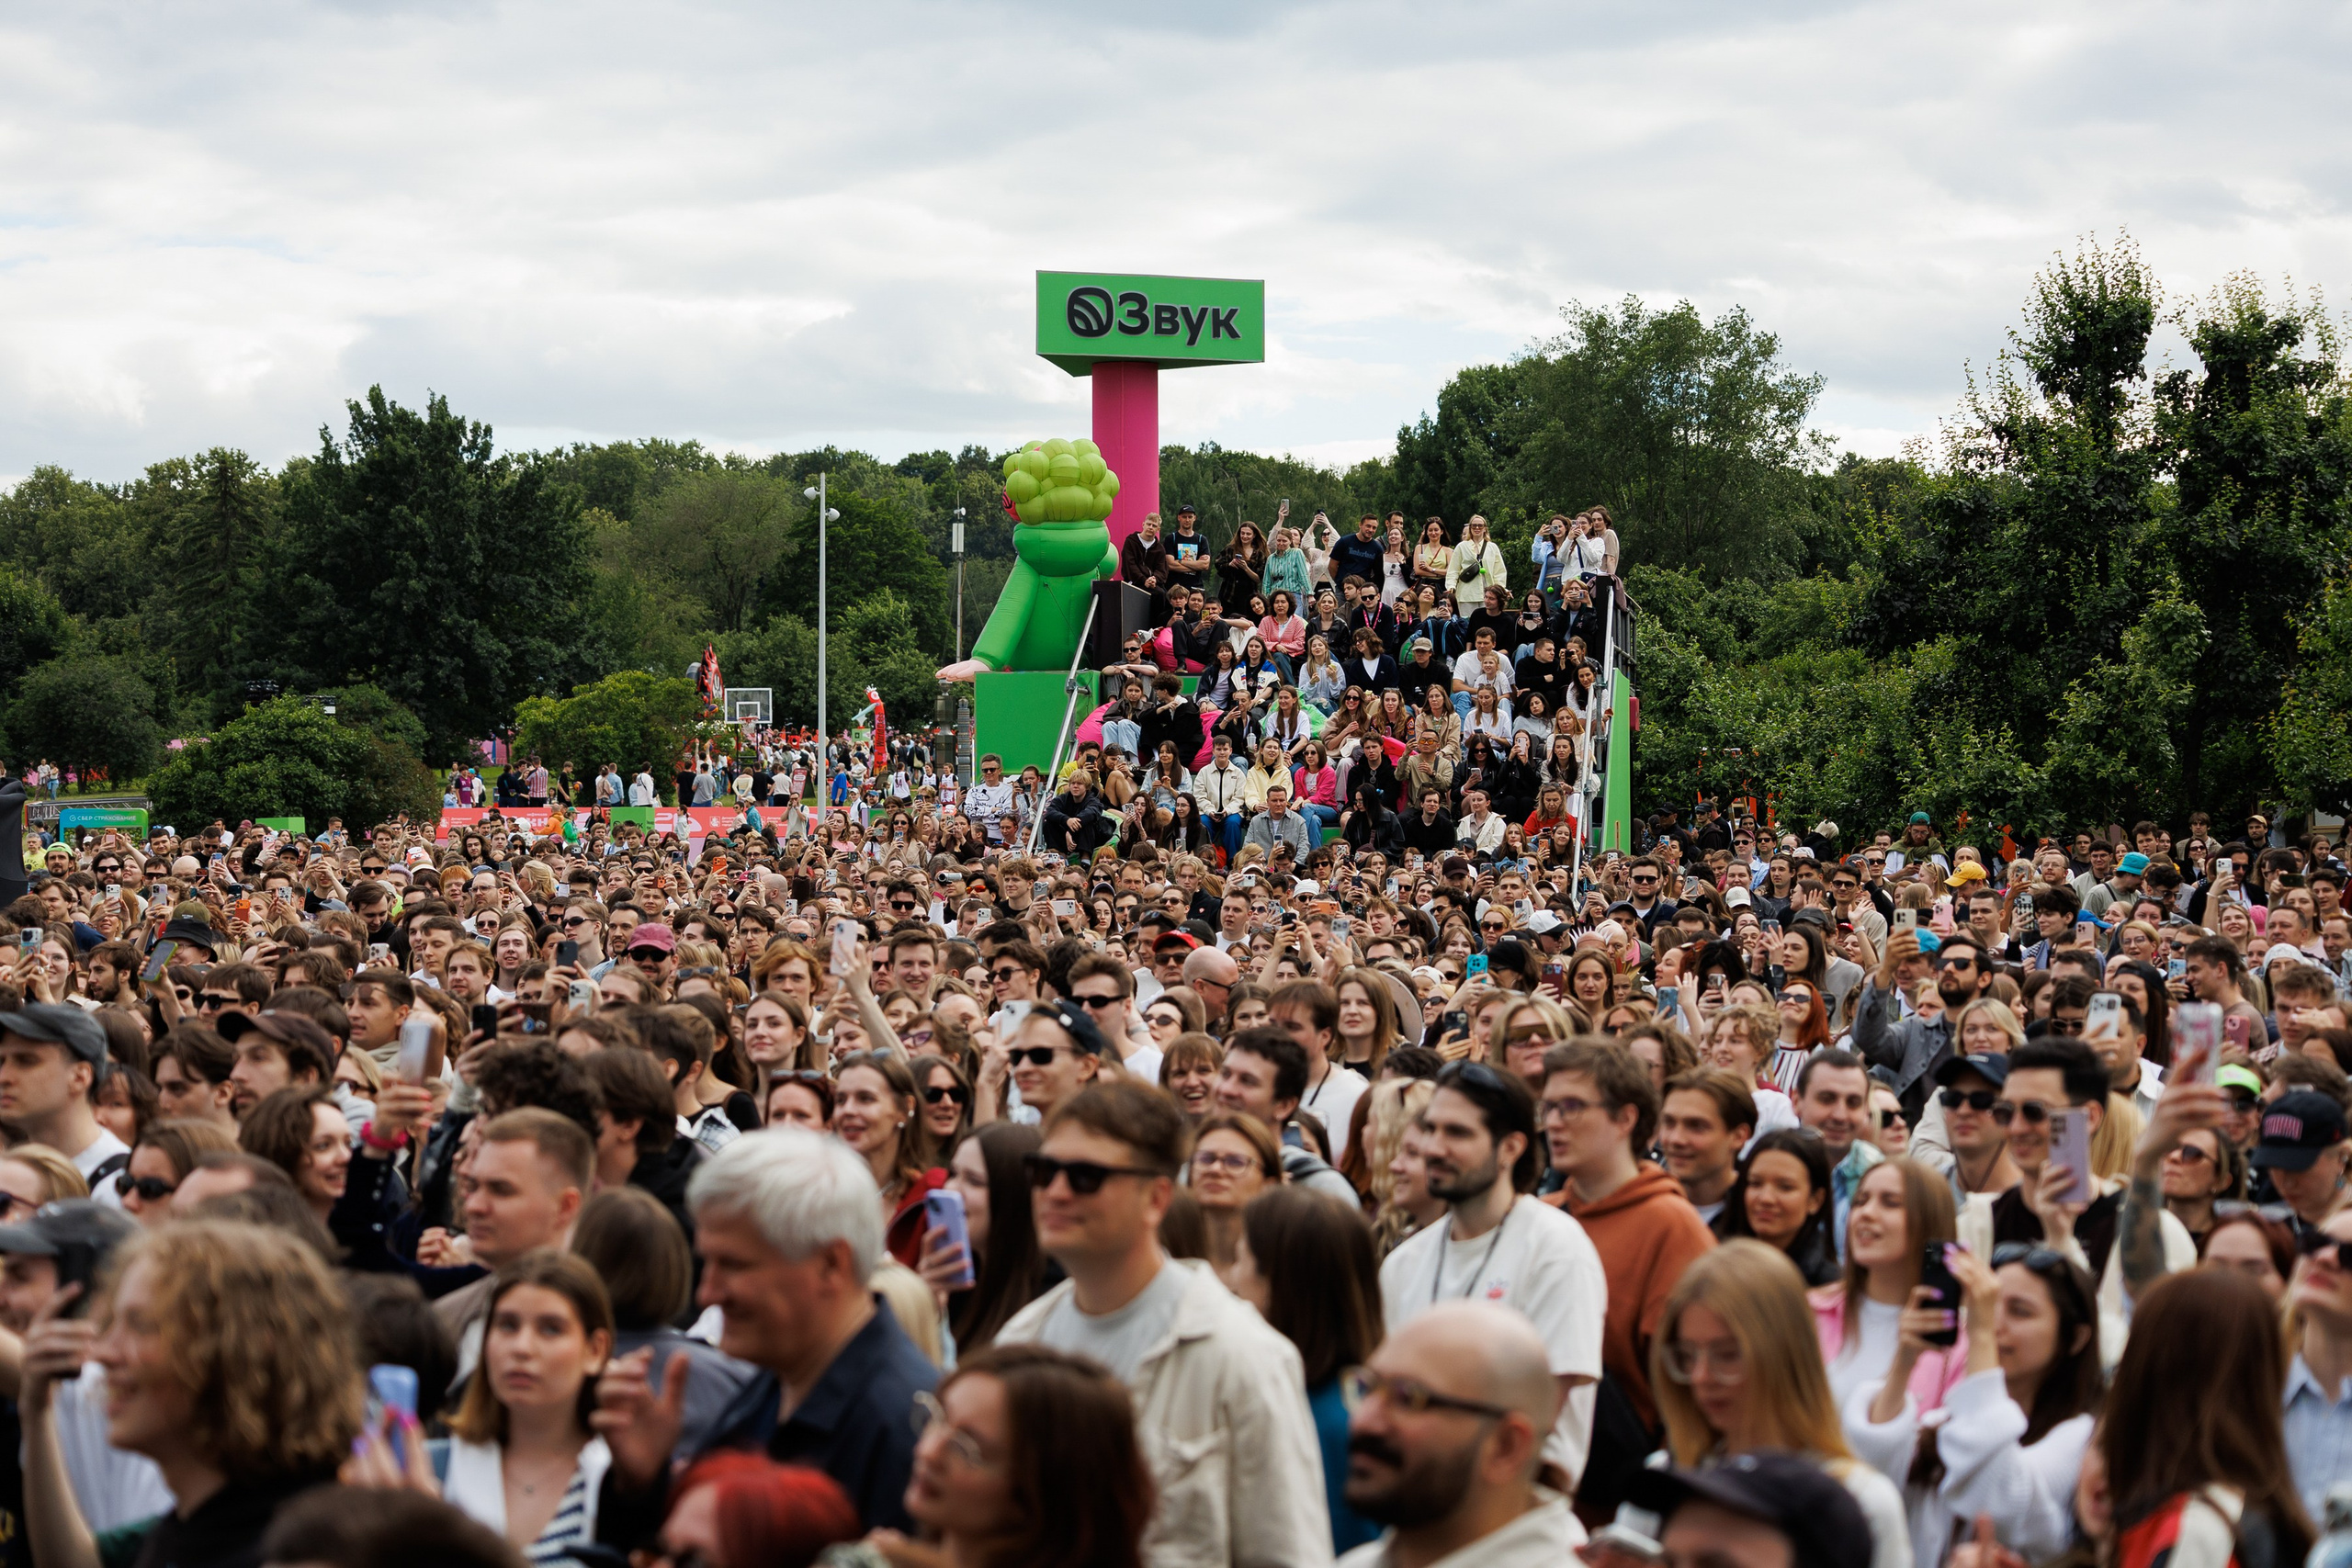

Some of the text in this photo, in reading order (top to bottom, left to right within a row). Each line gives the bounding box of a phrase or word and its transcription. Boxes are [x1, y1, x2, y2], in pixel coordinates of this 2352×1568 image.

[1117, 291, 1241, 346] Звук
[1349, 547, 1376, 559] Timberland
[876, 728, 885, 747] World
